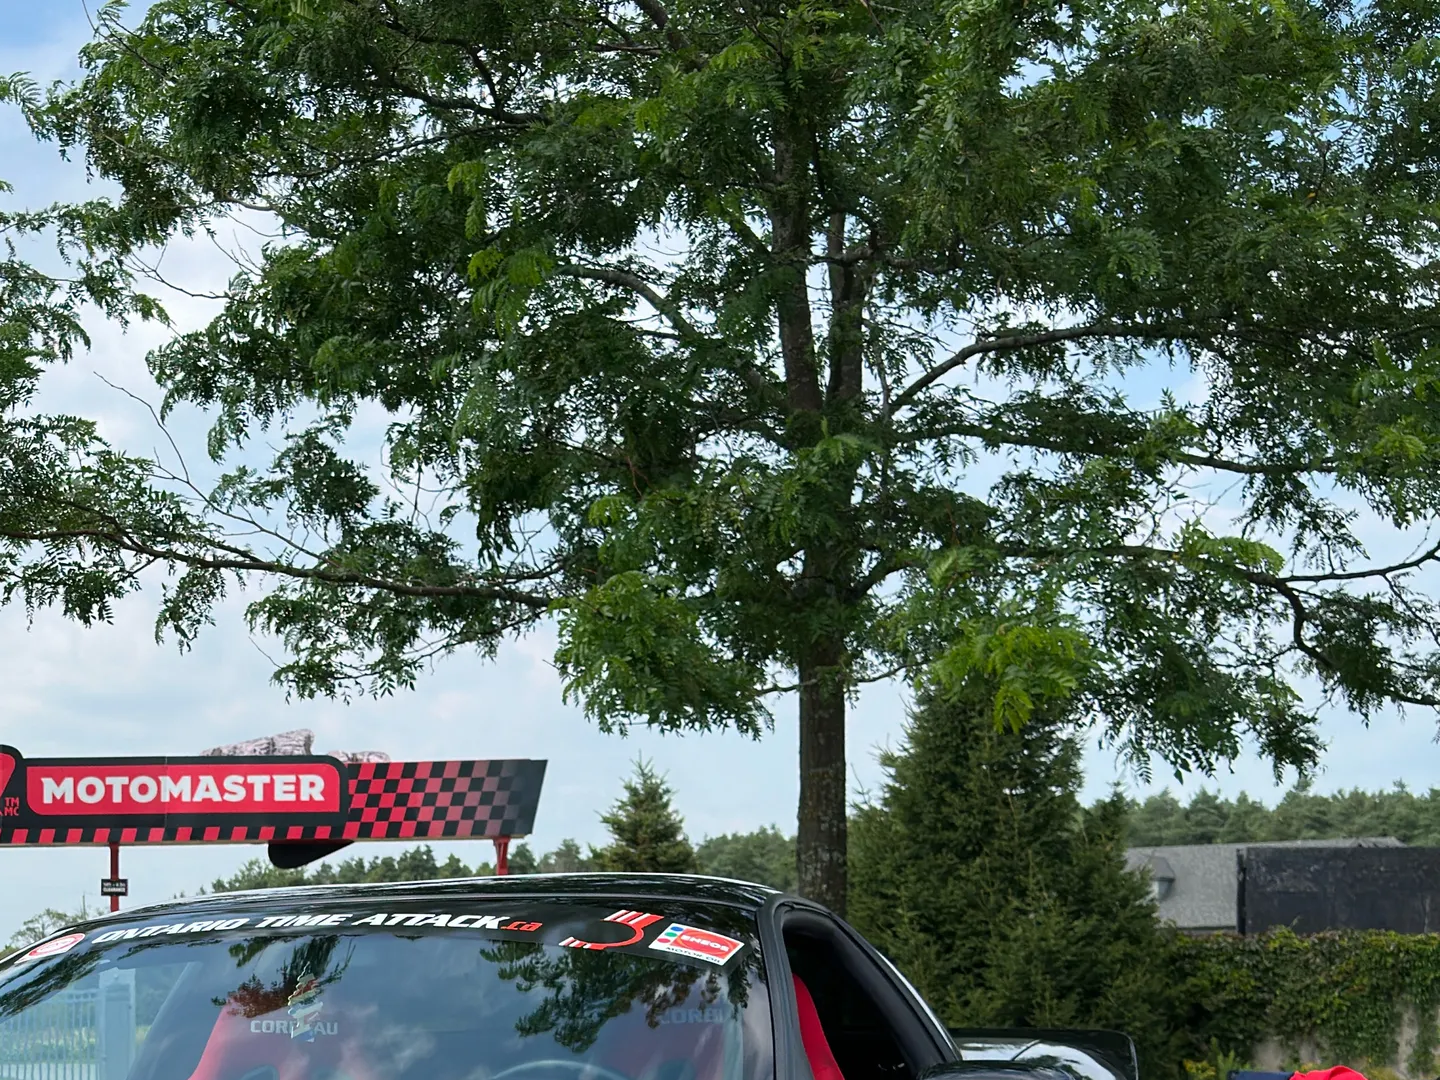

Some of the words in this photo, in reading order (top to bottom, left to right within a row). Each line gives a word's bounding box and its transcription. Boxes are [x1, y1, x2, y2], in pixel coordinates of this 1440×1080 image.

[41, 775, 325, 804] MOTOMASTER
[4, 796, 20, 807] TM
[4, 806, 20, 817] MC
[91, 917, 251, 944] ONTARIO
[254, 913, 353, 928] TIME
[680, 934, 730, 952] ENEOS
